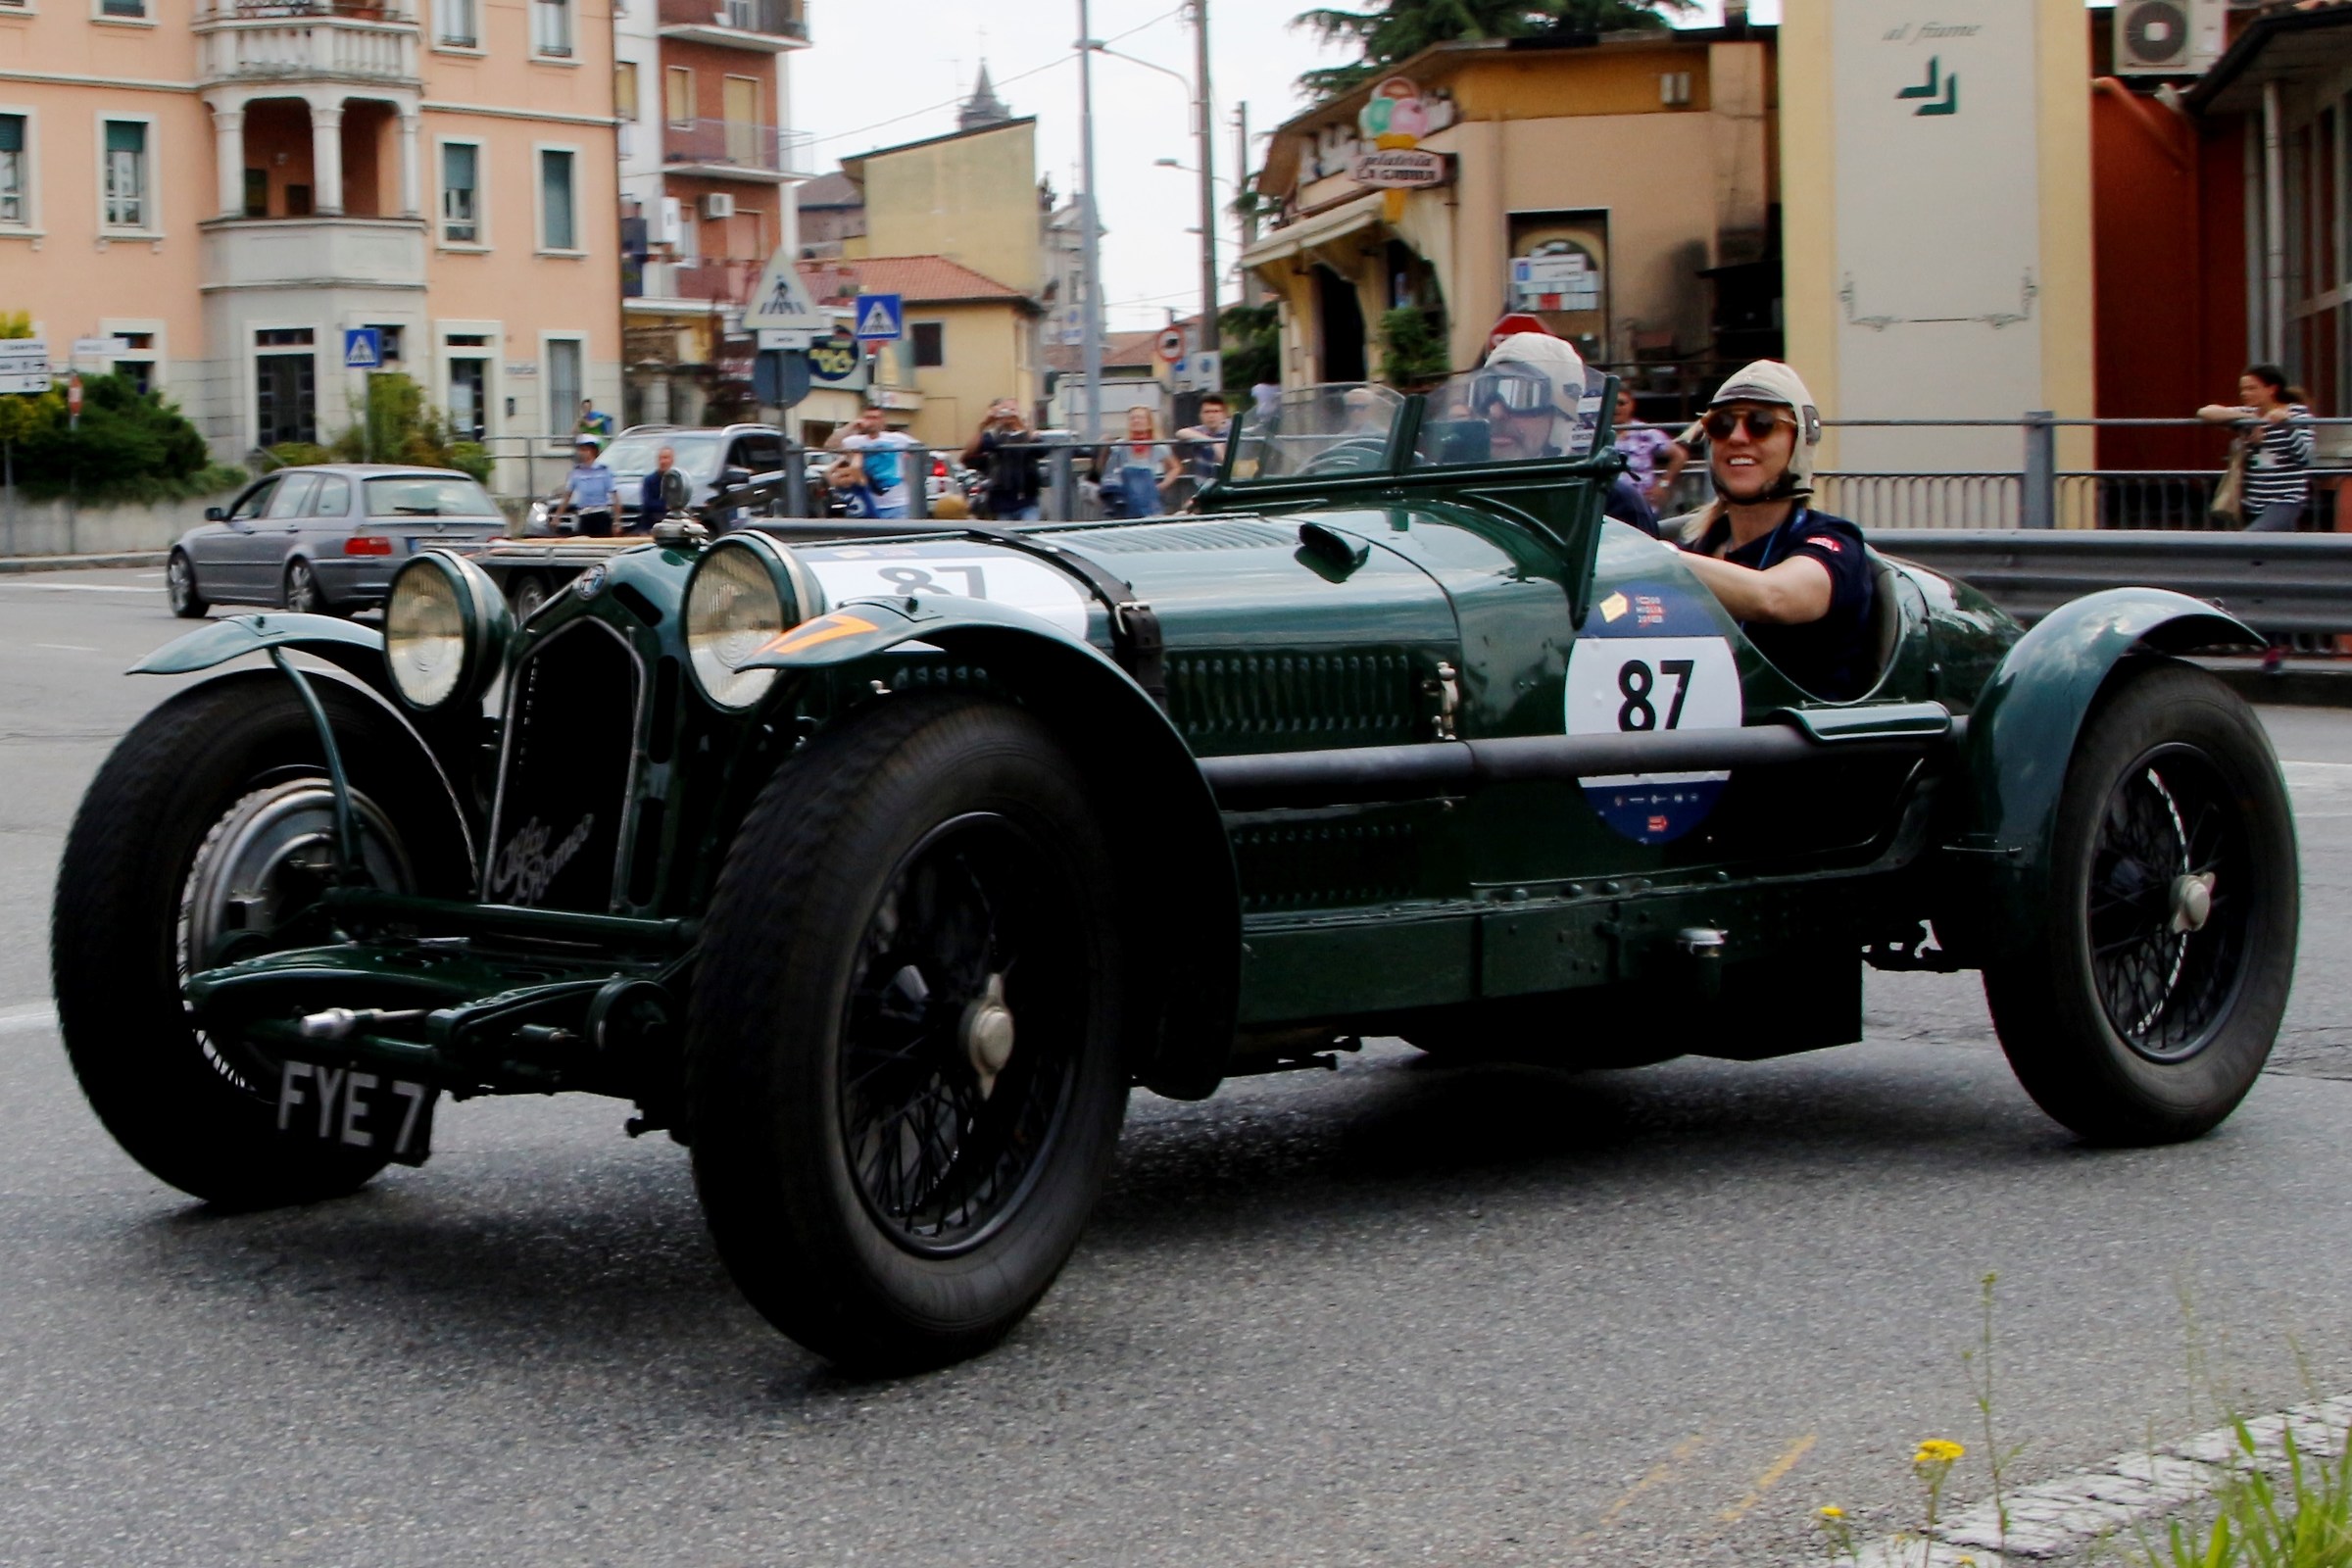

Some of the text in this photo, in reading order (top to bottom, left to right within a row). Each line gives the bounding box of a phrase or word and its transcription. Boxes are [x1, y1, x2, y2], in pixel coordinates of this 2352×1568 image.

[878, 564, 988, 600] 87
[1618, 659, 1694, 732] 87
[493, 815, 551, 894] Alfa
[509, 812, 594, 906] Romeo
[277, 1059, 425, 1154] FYE 7
